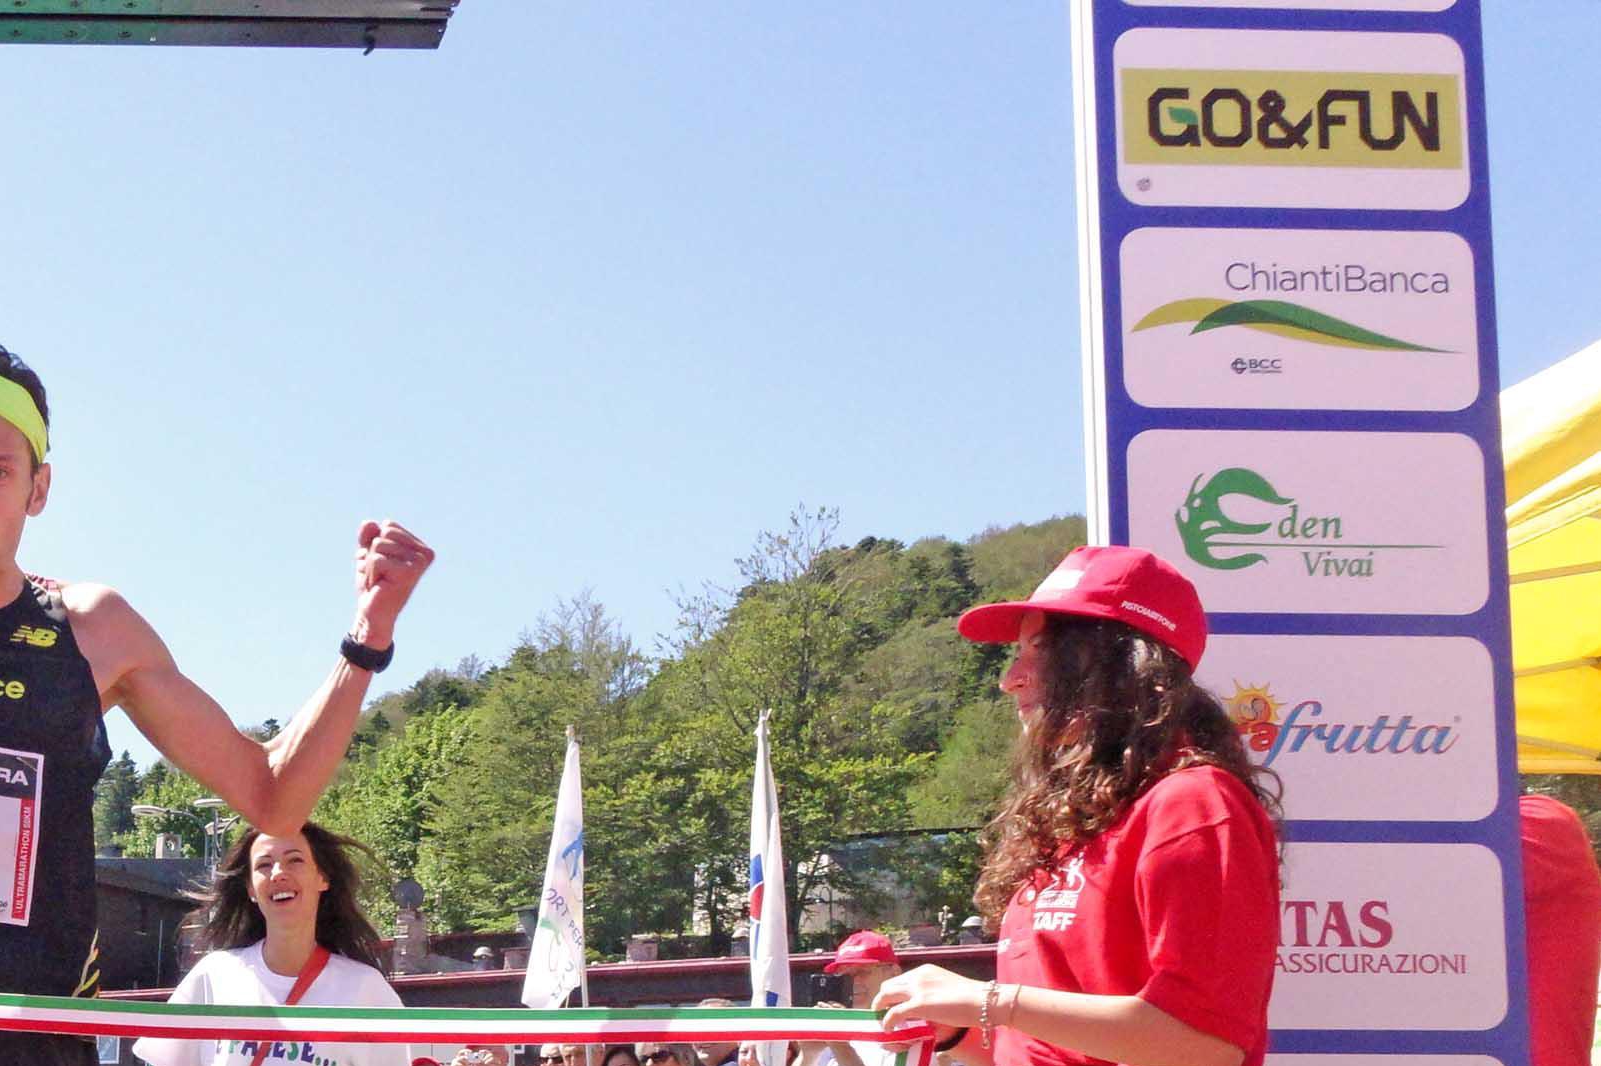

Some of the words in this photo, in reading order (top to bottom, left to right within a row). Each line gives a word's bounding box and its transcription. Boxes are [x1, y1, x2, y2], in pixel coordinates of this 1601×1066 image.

[1147, 88, 1440, 151] GO&FUN
[1224, 262, 1450, 293] ChiantiBanca
[1249, 358, 1283, 369] BCC
[1302, 551, 1374, 577] Vivai
[1032, 911, 1078, 931] TAFF
